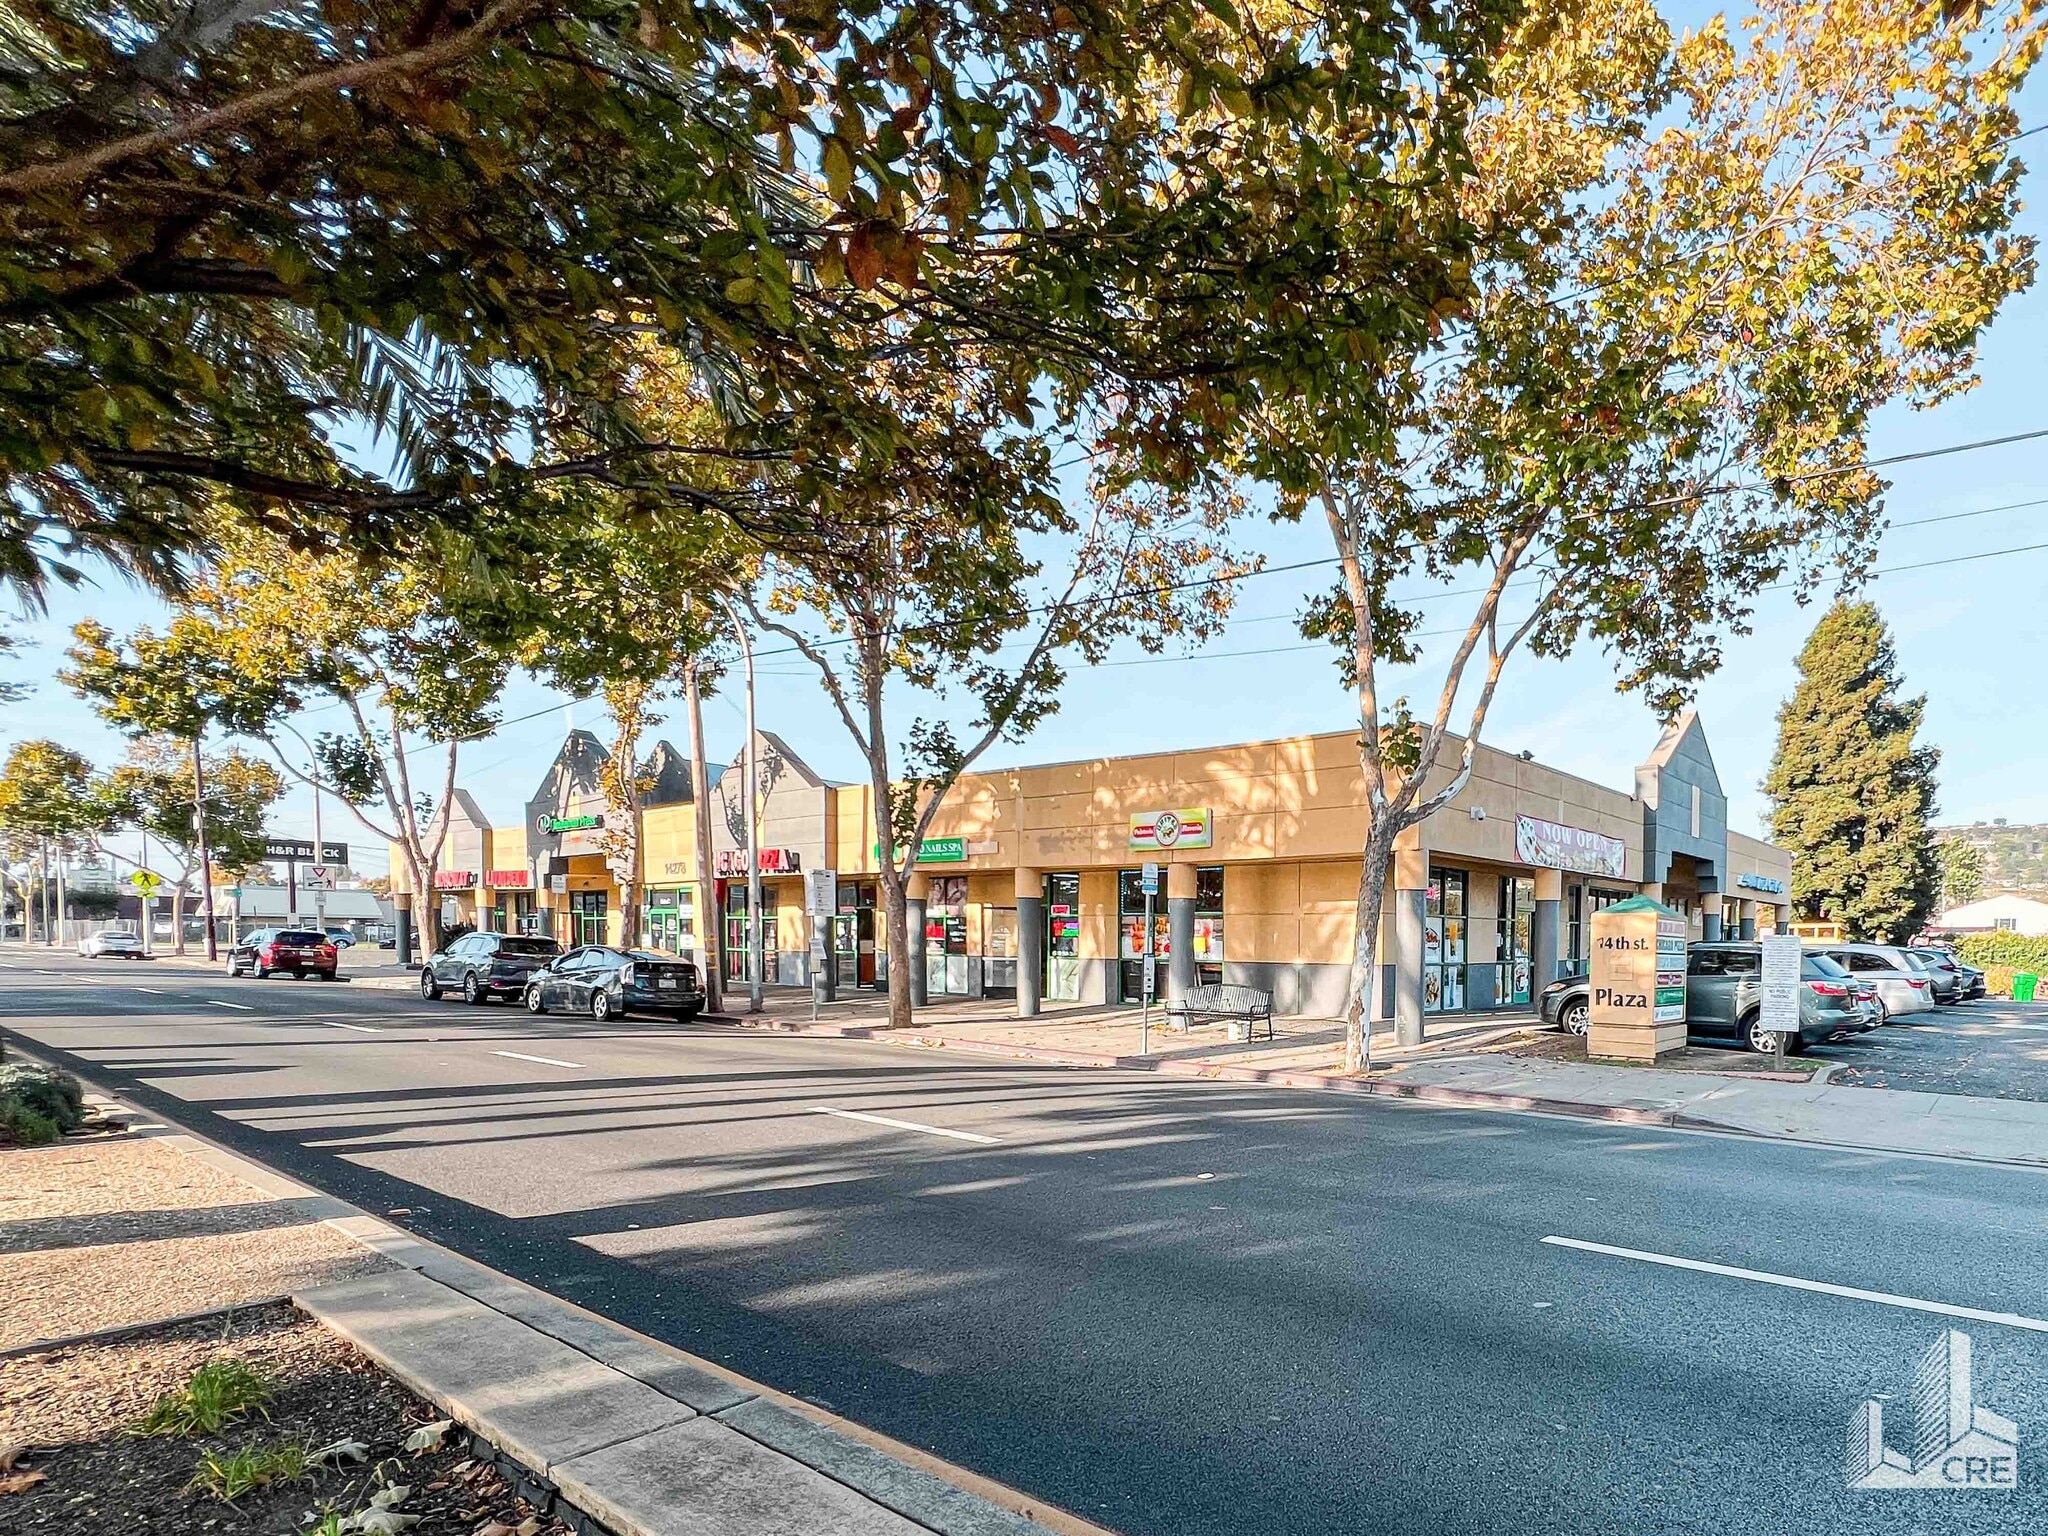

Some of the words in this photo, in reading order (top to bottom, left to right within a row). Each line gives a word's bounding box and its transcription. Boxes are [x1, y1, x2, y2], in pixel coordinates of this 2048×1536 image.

[1543, 822, 1572, 844] NOW
[1577, 831, 1608, 851] OPEN
[266, 845, 295, 855] H&R
[297, 847, 340, 858] BLCK
[926, 843, 948, 853] NAILS
[948, 843, 962, 852] SPA
[1633, 937, 1649, 950] st.
[1595, 988, 1648, 1008] Plaza
